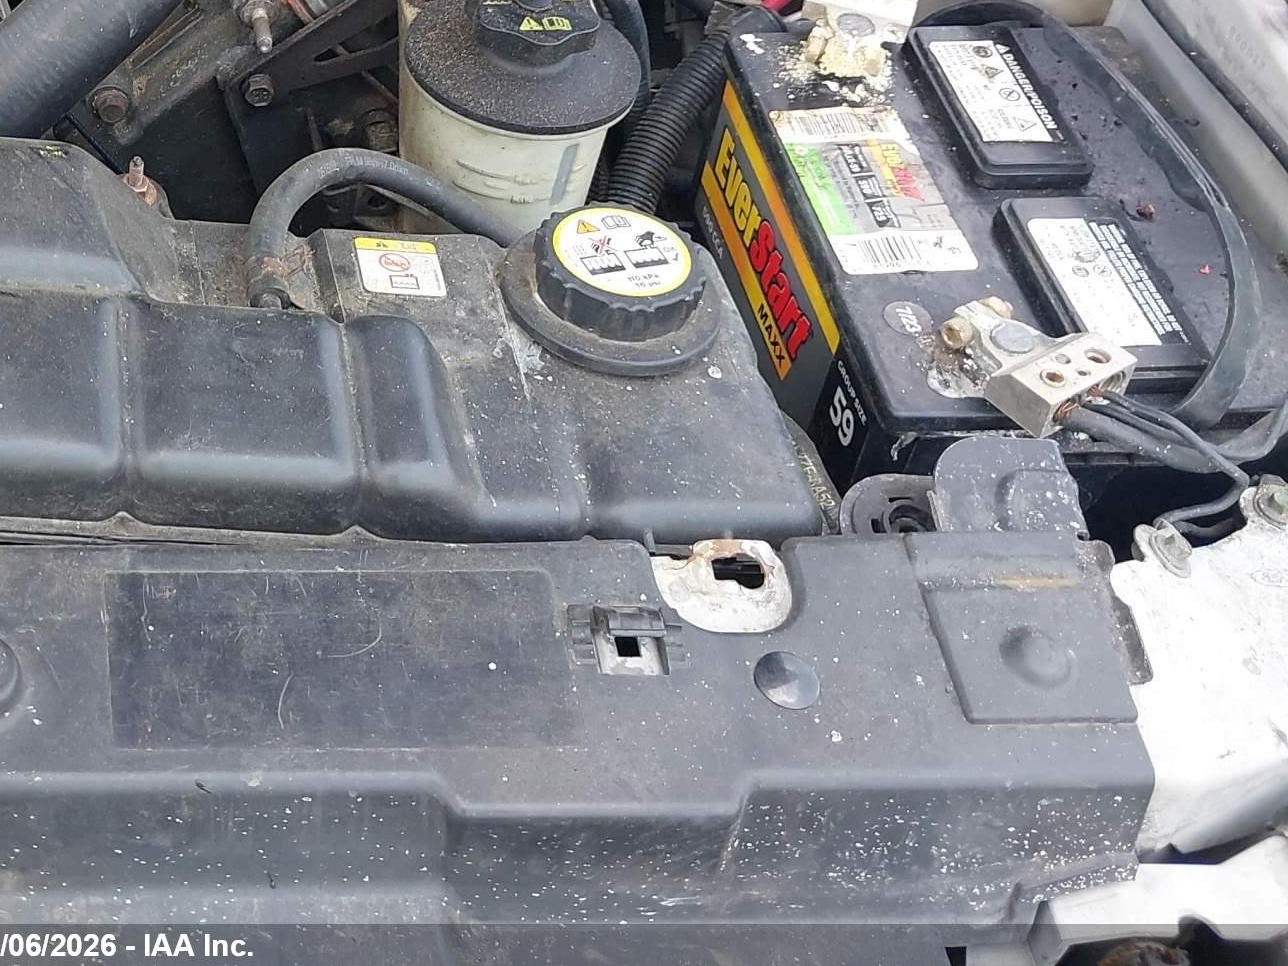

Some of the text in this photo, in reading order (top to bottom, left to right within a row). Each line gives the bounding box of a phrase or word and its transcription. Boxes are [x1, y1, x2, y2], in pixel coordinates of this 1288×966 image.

[713, 126, 812, 362] EverStart
[757, 302, 786, 369] MAXX
[896, 306, 921, 336] 7/23
[829, 386, 854, 446] 59
[837, 360, 868, 427] GROUP SIZE
